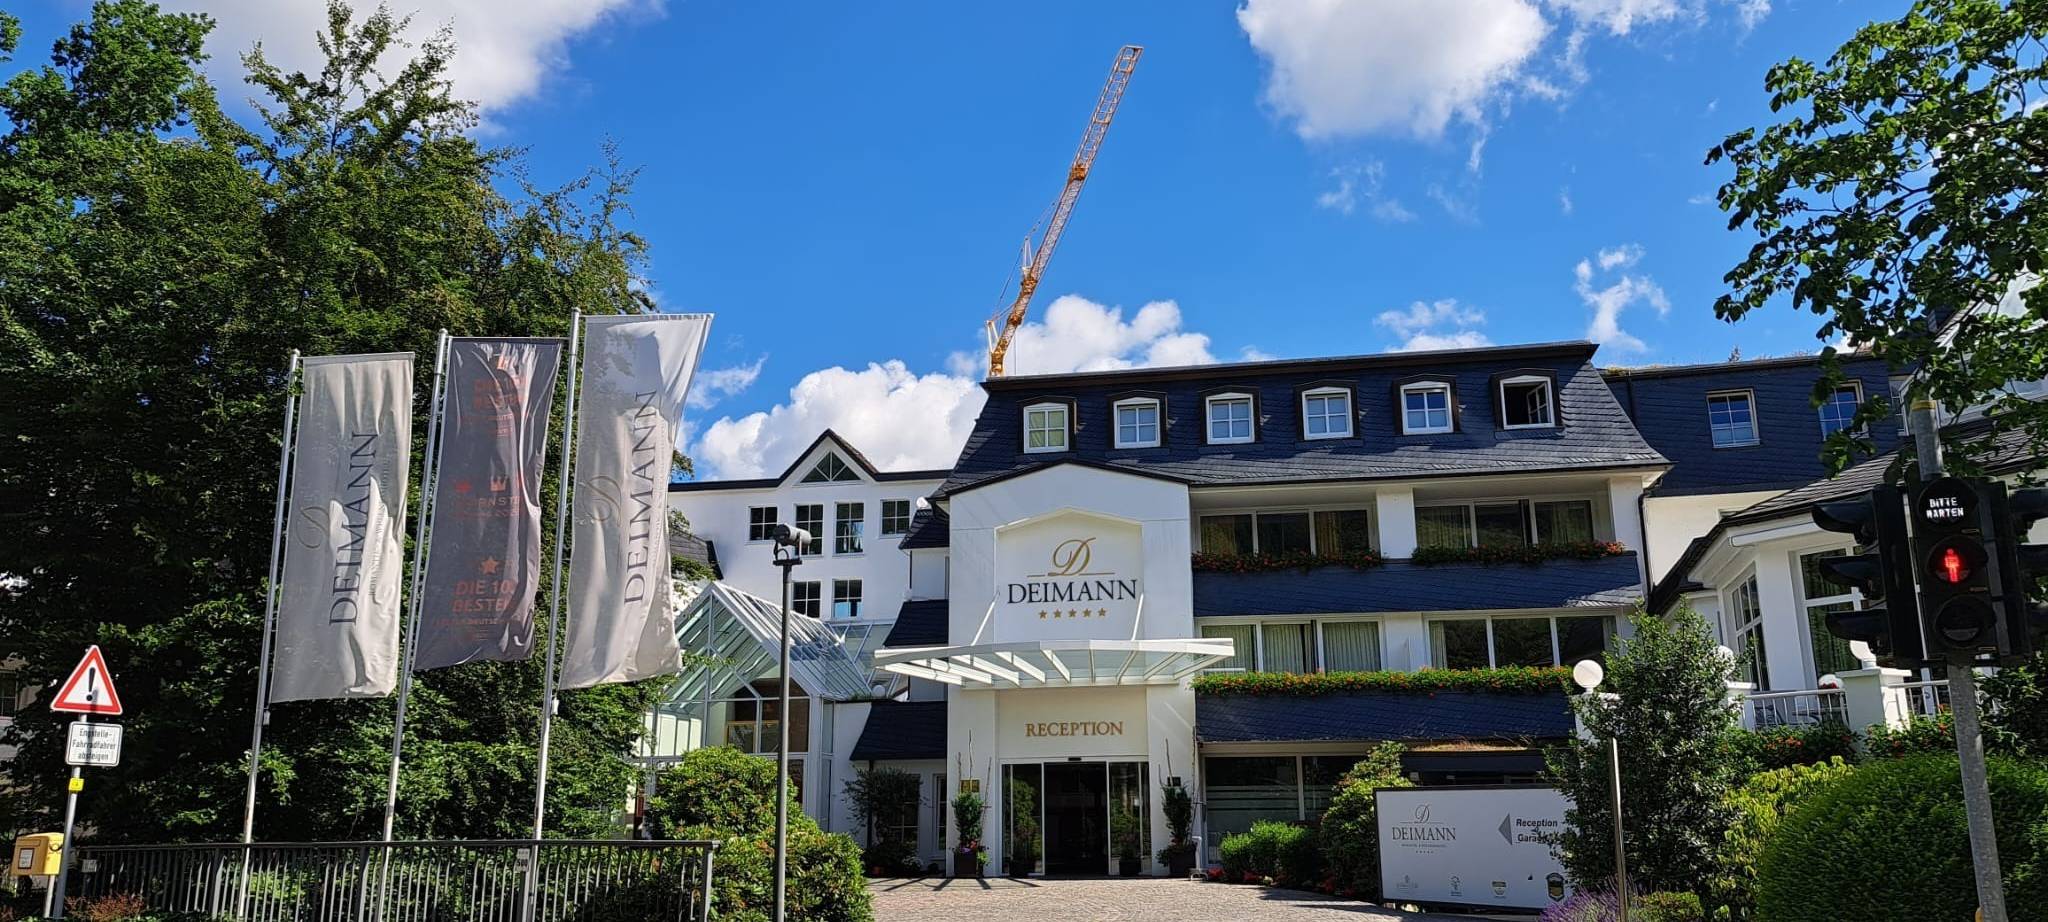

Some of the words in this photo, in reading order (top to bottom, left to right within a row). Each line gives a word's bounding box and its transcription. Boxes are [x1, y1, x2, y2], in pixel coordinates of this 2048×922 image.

[624, 390, 657, 605] DEIMANN
[1929, 497, 1958, 507] BITTE
[329, 432, 379, 626] DEIMANN
[1047, 537, 1097, 577] D
[454, 580, 485, 596] DIE
[1007, 579, 1138, 604] DEIMANN
[1024, 721, 1123, 737] RECEPTION
[1515, 818, 1558, 828] Reception
[1392, 827, 1457, 841] DEIMANN
[1517, 833, 1548, 844] Gara
